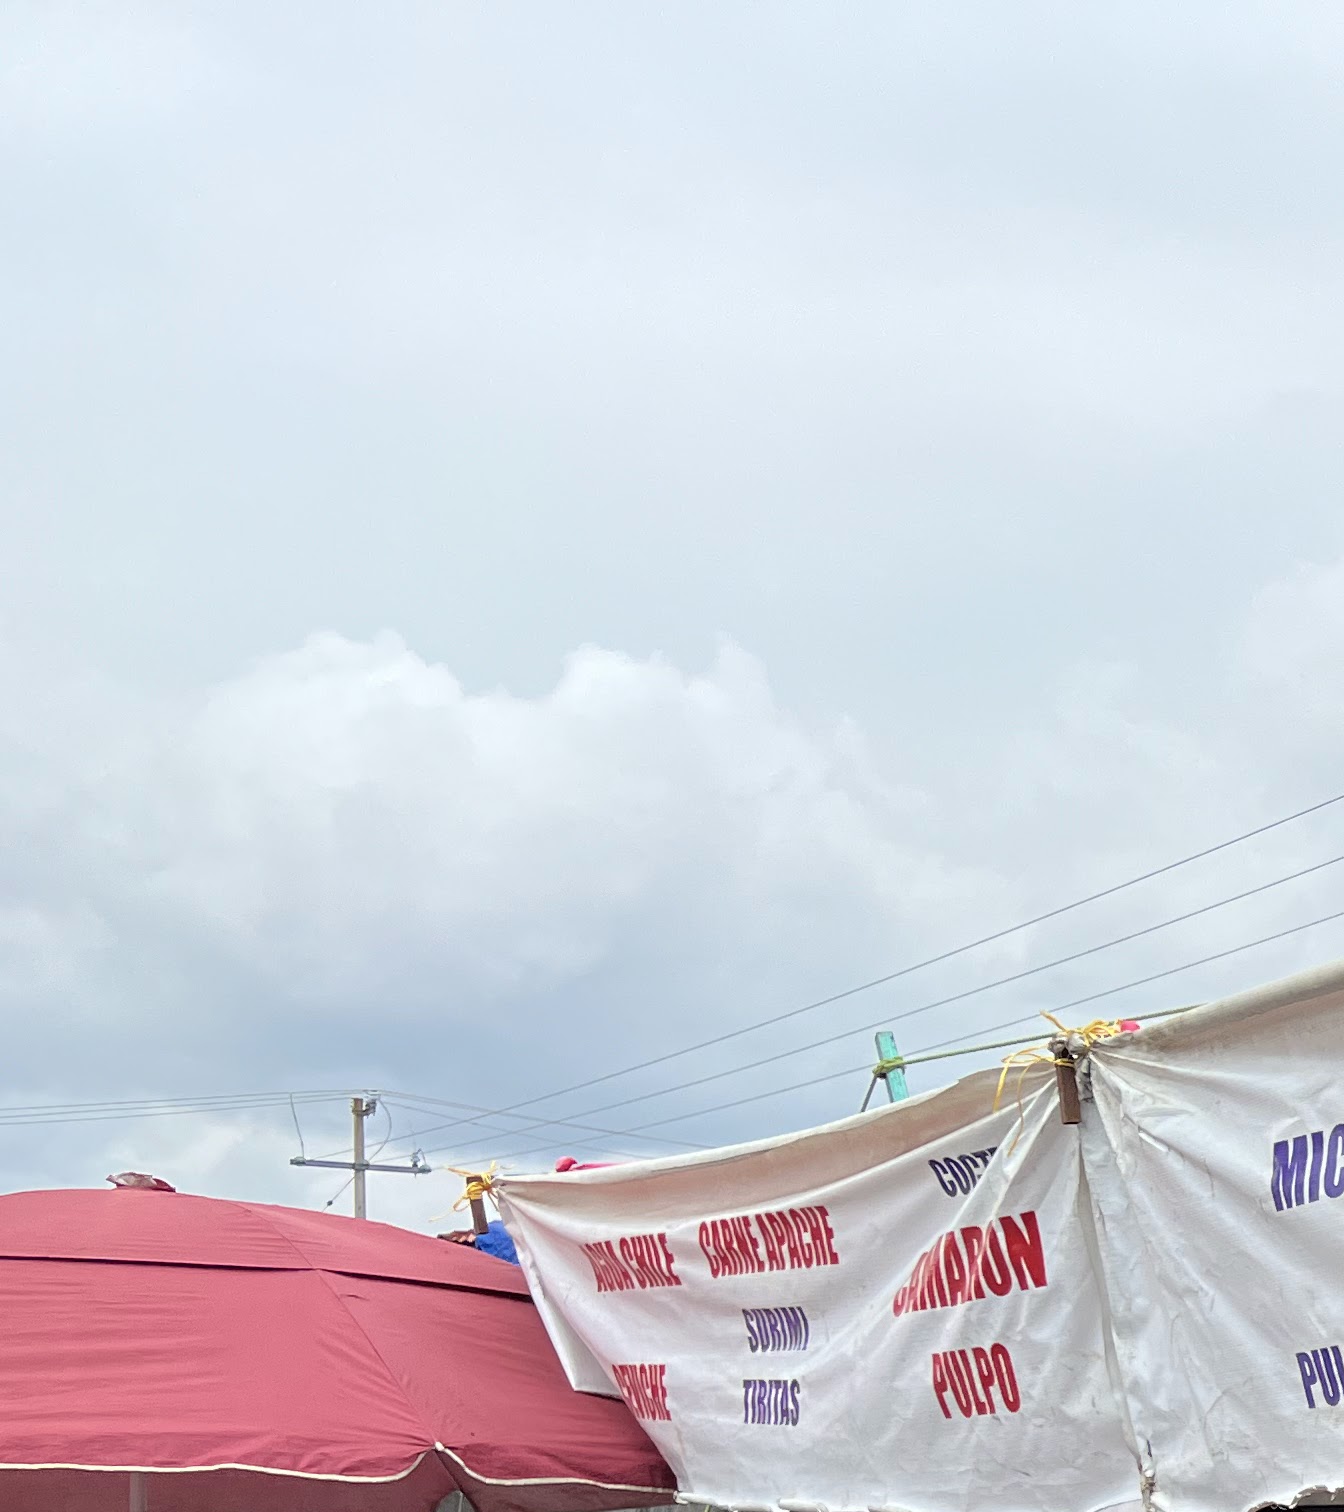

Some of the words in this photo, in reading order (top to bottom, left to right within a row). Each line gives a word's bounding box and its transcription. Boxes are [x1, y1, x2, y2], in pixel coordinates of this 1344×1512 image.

[584, 1240, 636, 1292] AGUA
[619, 1233, 682, 1289] CHILE
[699, 1217, 766, 1279] CARNE
[757, 1206, 839, 1272] APACHE
[742, 1306, 810, 1353] SURIMI
[743, 1378, 801, 1427] TIRITAS
[932, 1342, 1021, 1419] PULPO
